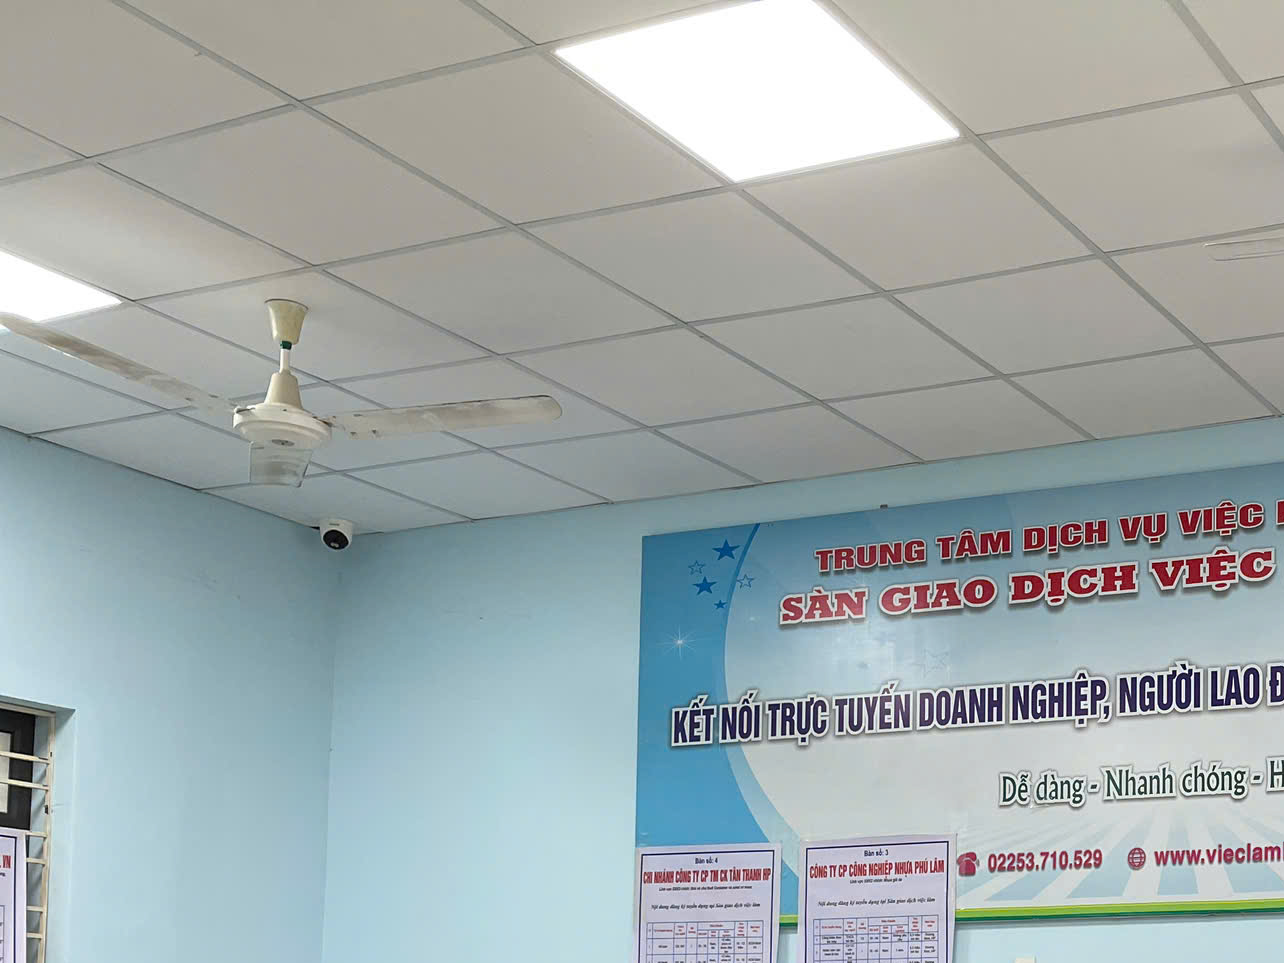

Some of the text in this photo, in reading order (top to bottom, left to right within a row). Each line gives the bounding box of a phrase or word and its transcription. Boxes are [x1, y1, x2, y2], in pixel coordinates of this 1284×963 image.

[815, 539, 926, 572] TRUNG
[936, 529, 1011, 559] TÂM
[1023, 519, 1108, 553] DỊCH
[1119, 513, 1167, 542] VỤ
[1178, 501, 1264, 535] VIỆC
[780, 587, 868, 624] SÀN
[880, 576, 997, 615] GIAO
[1008, 561, 1138, 606] DỊCH
[1150, 546, 1276, 591] VIỆC
[672, 695, 716, 746] KẾT
[719, 690, 762, 743] NỐI
[766, 694, 829, 746] TRỰC
[833, 680, 913, 735] TUYẾN
[917, 683, 1005, 730] DOANH
[1010, 669, 1112, 728] NGHIỆP,
[1117, 660, 1203, 717] NGƯỜI
[1208, 664, 1263, 711] LAO
[1000, 772, 1030, 805] Dễ
[1035, 772, 1085, 806] dàng
[1104, 765, 1175, 798] Nhanh
[1180, 762, 1248, 797] chóng
[809, 857, 945, 880] CÔNG TY CP CÔNG NGHIỆP NHỰA PHÚ LÂM
[987, 849, 1103, 873] 02253.710.529
